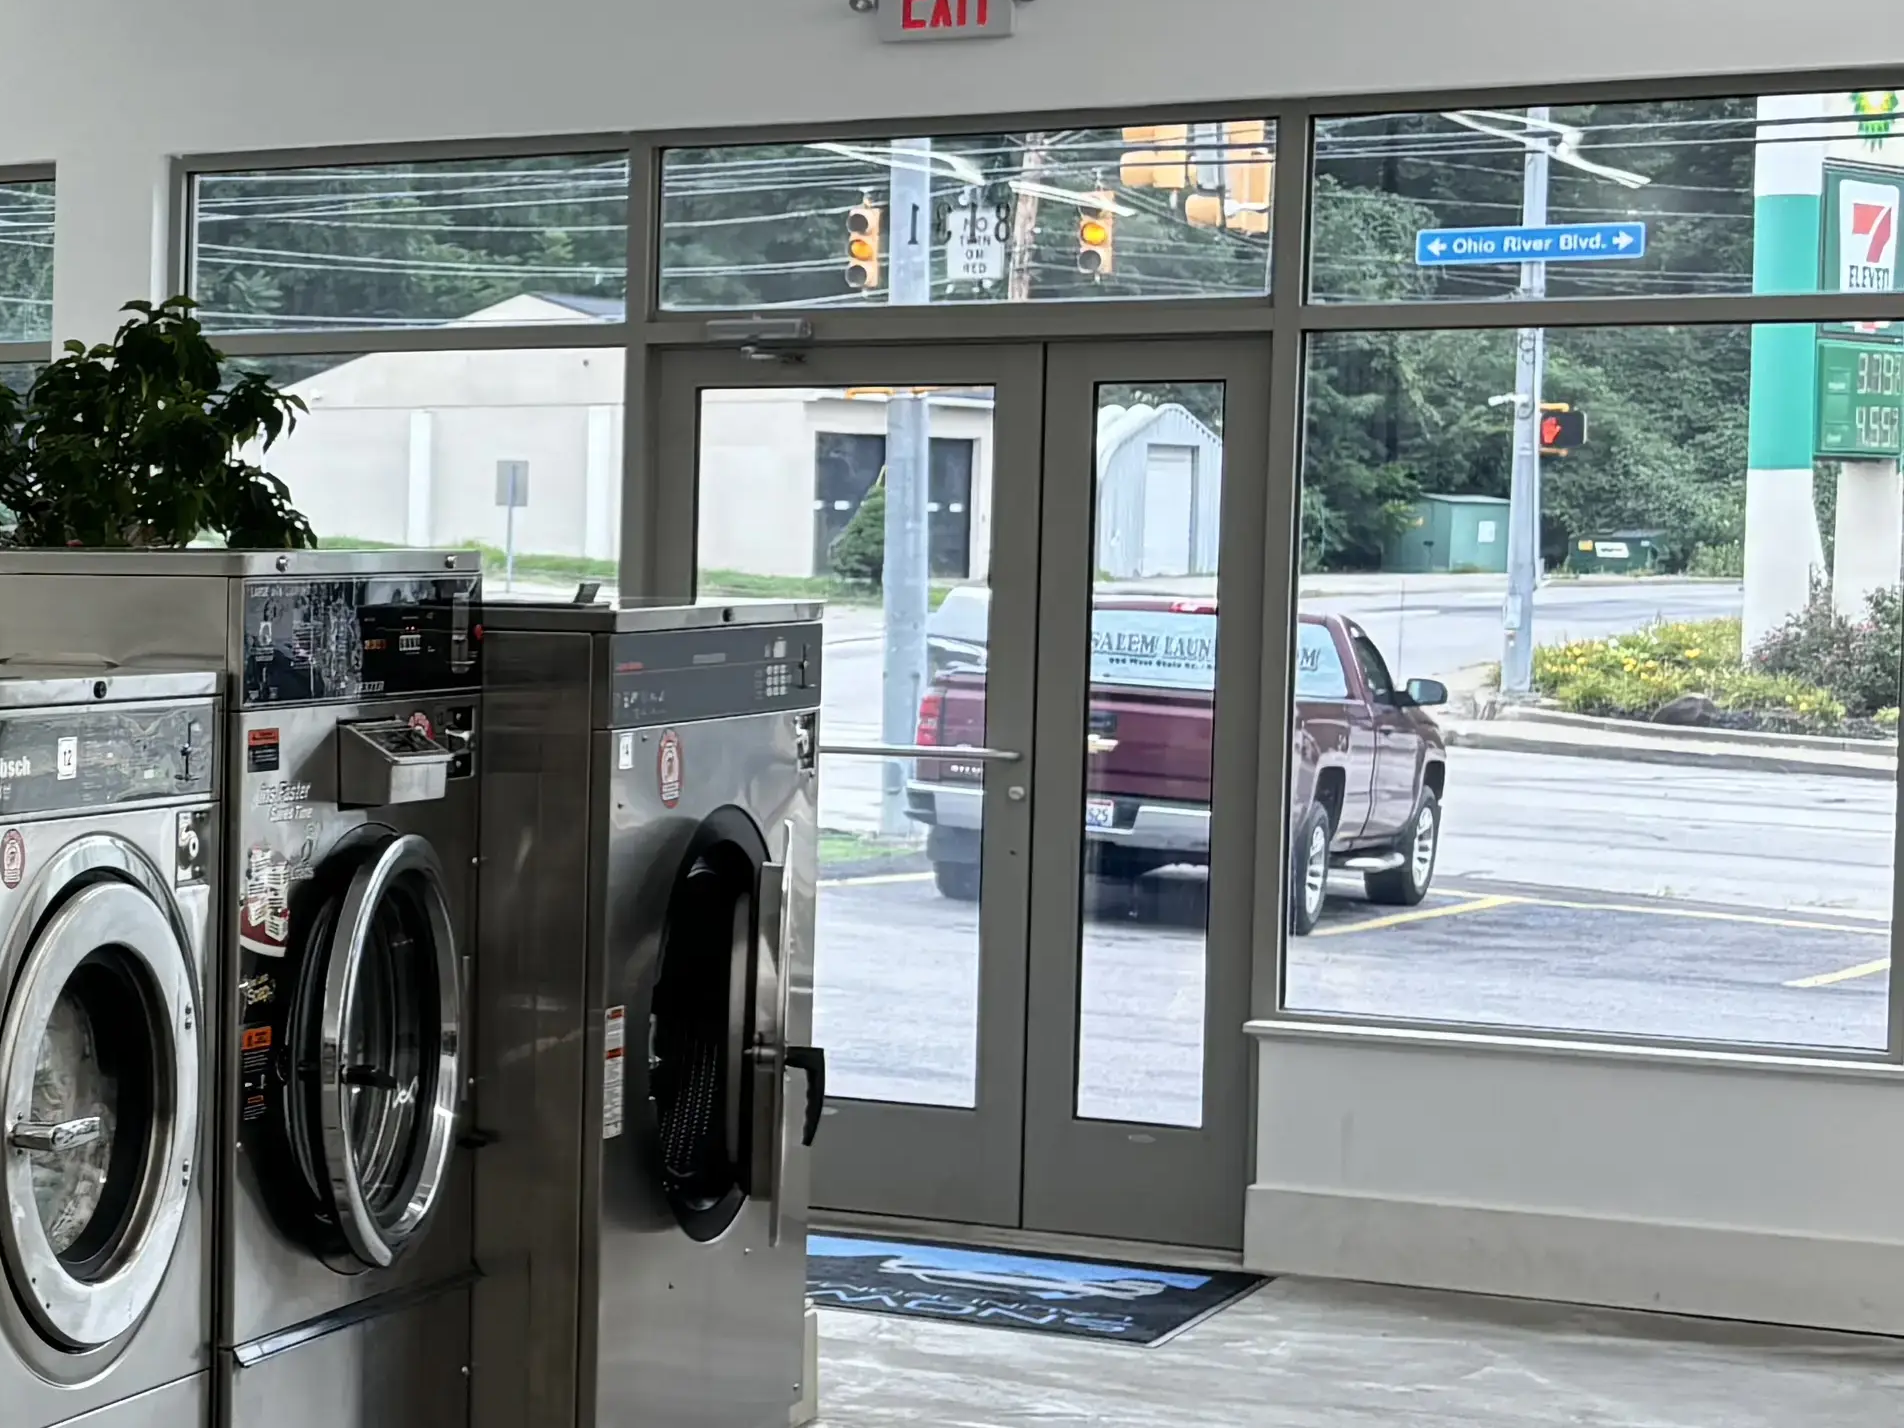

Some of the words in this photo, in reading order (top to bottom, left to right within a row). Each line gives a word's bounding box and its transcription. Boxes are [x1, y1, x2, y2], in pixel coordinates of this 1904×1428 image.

[1852, 202, 1893, 263] 7
[1452, 236, 1496, 254] Ohio
[1502, 235, 1553, 252] River
[1559, 232, 1608, 250] Blvd.
[965, 248, 984, 260] ON
[962, 263, 987, 274] RED
